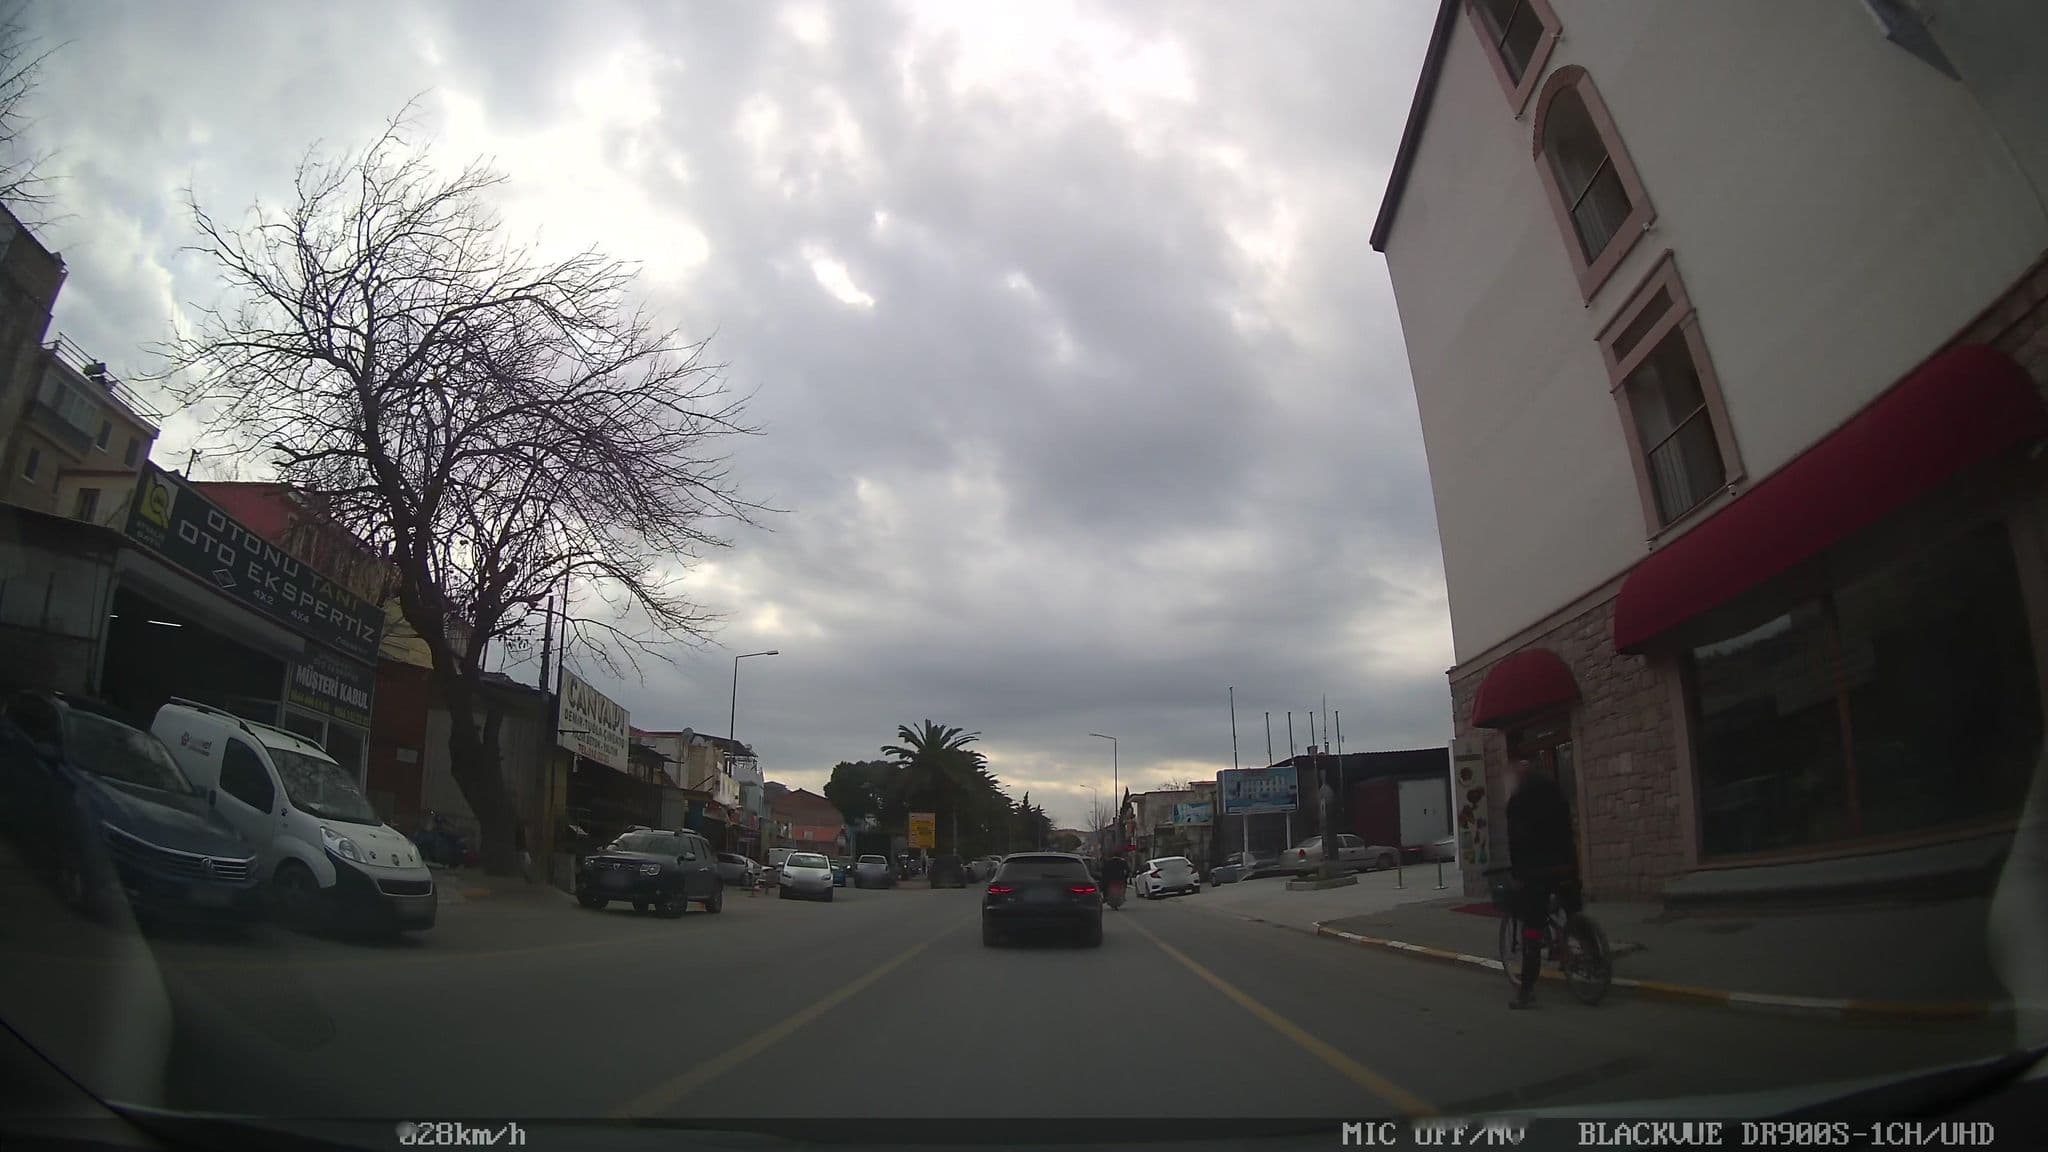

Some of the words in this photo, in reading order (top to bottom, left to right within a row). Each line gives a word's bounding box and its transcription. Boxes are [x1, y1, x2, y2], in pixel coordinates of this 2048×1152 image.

[178, 519, 236, 568] OTO
[247, 561, 376, 643] EKSPERTİZ
[207, 508, 300, 579] OTONU
[310, 572, 357, 612] TANI
[295, 663, 339, 697] MÜŞTERİ
[339, 682, 369, 709] KABUL
